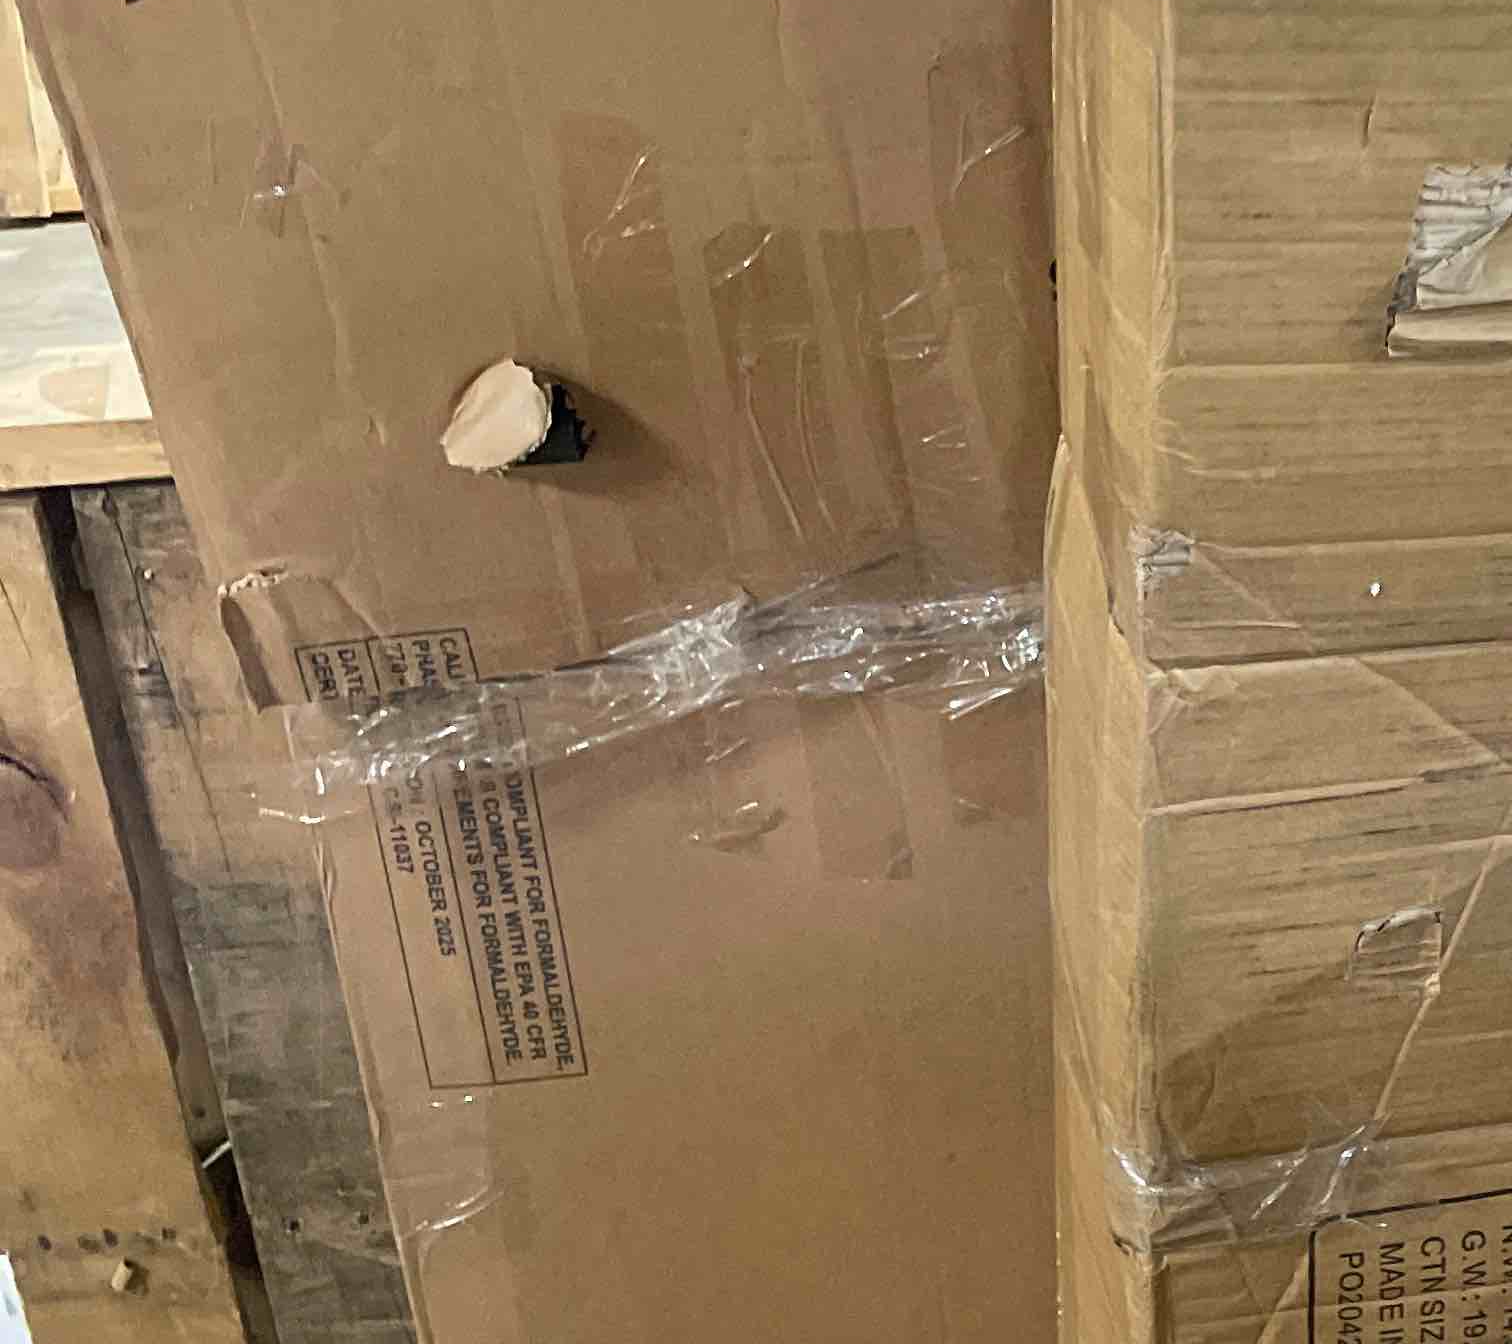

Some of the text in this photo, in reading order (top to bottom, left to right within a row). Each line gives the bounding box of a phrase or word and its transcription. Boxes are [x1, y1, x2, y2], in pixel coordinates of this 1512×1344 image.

[482, 798, 519, 905] COMPLIANT
[414, 822, 449, 914] OCTOBER
[433, 917, 456, 956] 2025
[470, 873, 490, 908] FOR
[526, 877, 545, 914] FOR
[505, 912, 527, 954] WITH
[514, 958, 533, 998] EPA
[521, 1001, 537, 1023] 40
[526, 1024, 547, 1060] CFR
[1378, 1241, 1405, 1321] MADE
[1419, 1235, 1445, 1293] CTN
